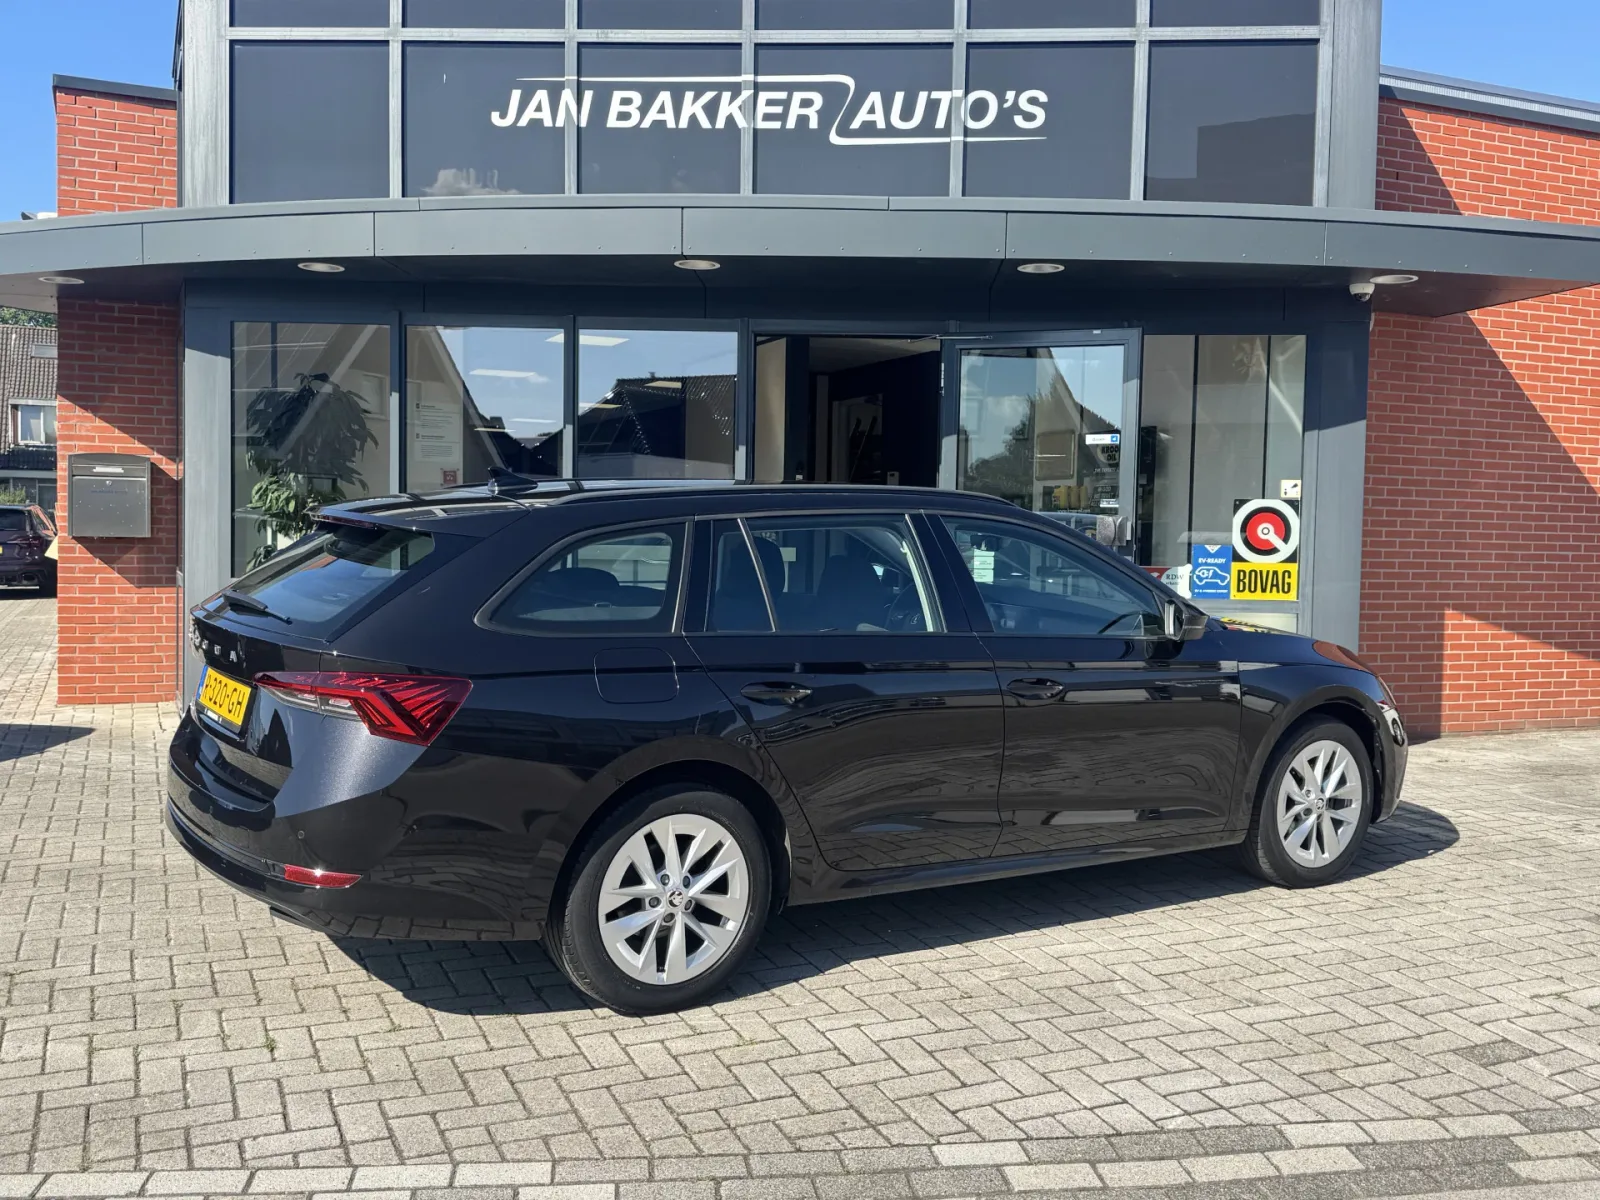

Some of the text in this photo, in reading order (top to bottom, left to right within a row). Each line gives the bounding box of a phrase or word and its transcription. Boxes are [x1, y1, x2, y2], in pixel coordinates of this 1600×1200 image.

[491, 88, 1049, 130] JAN BAKKER AUTO'S
[1236, 569, 1292, 595] BOVAG
[203, 673, 246, 719] R-320-GH
